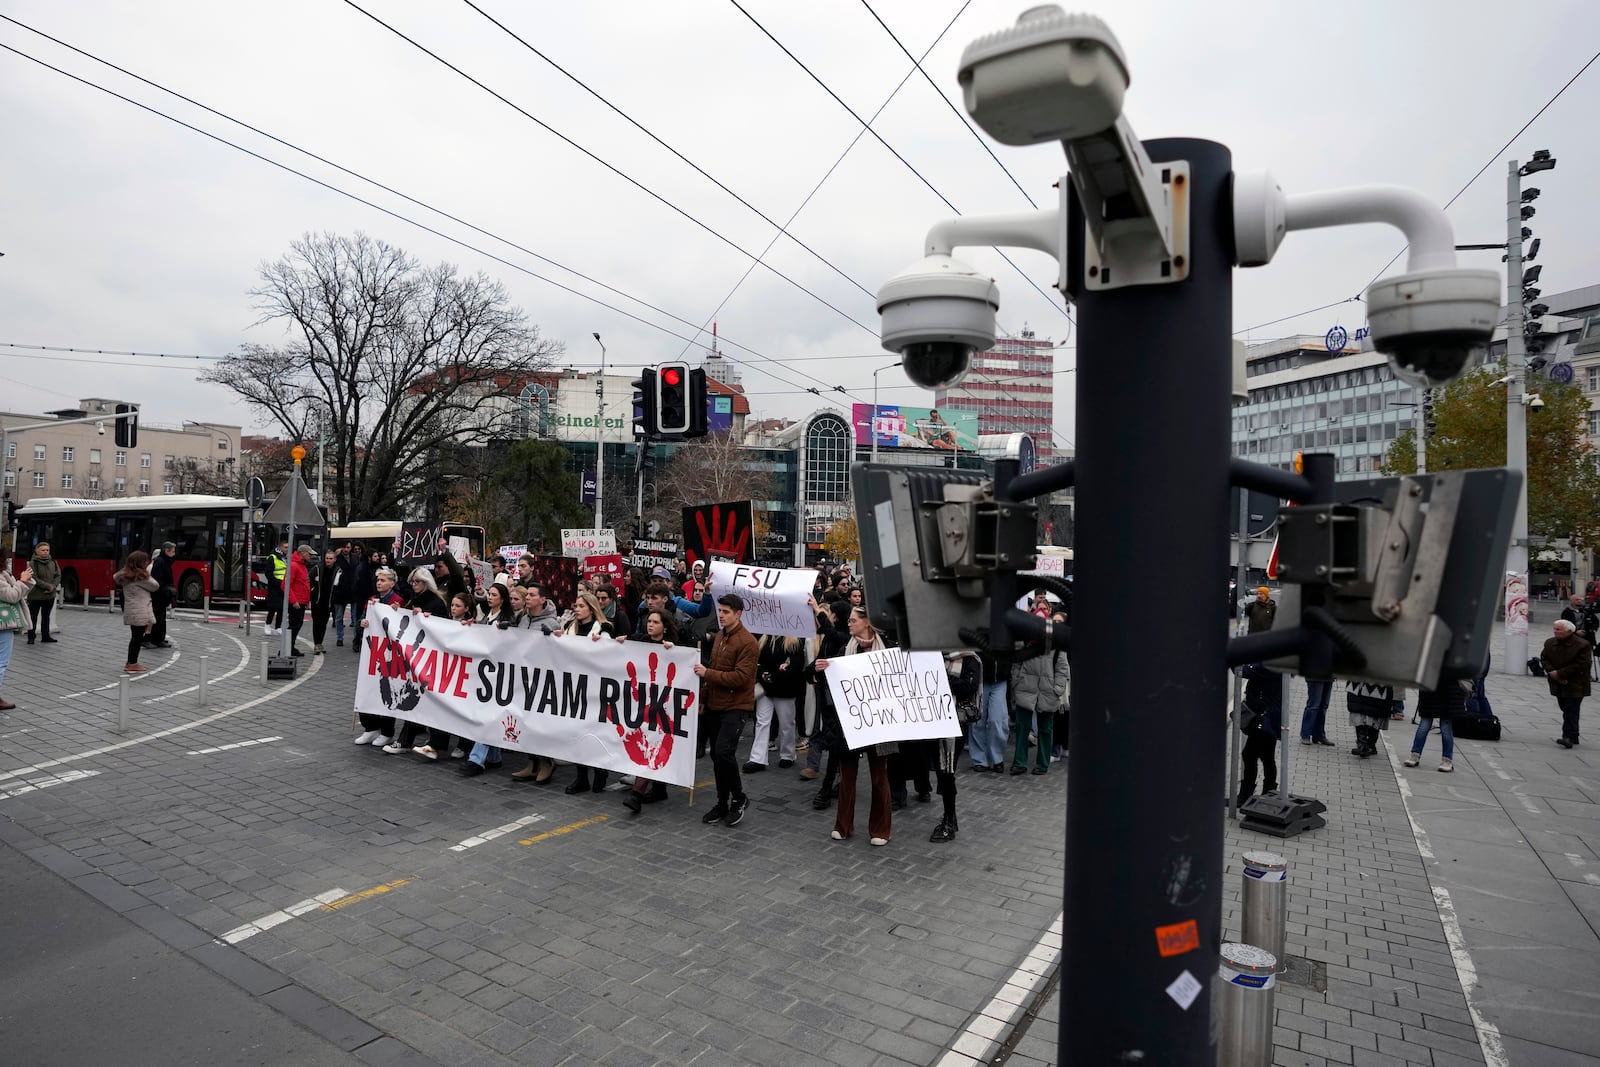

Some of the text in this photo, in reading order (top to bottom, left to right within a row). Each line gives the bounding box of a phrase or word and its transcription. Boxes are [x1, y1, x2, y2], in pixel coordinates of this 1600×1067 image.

[545, 413, 624, 428] Heineken
[732, 567, 781, 589] FSU
[868, 649, 914, 675] НАШИ
[368, 635, 691, 739] KRVAVE SU VAM RUKE
[924, 669, 939, 696] СУ
